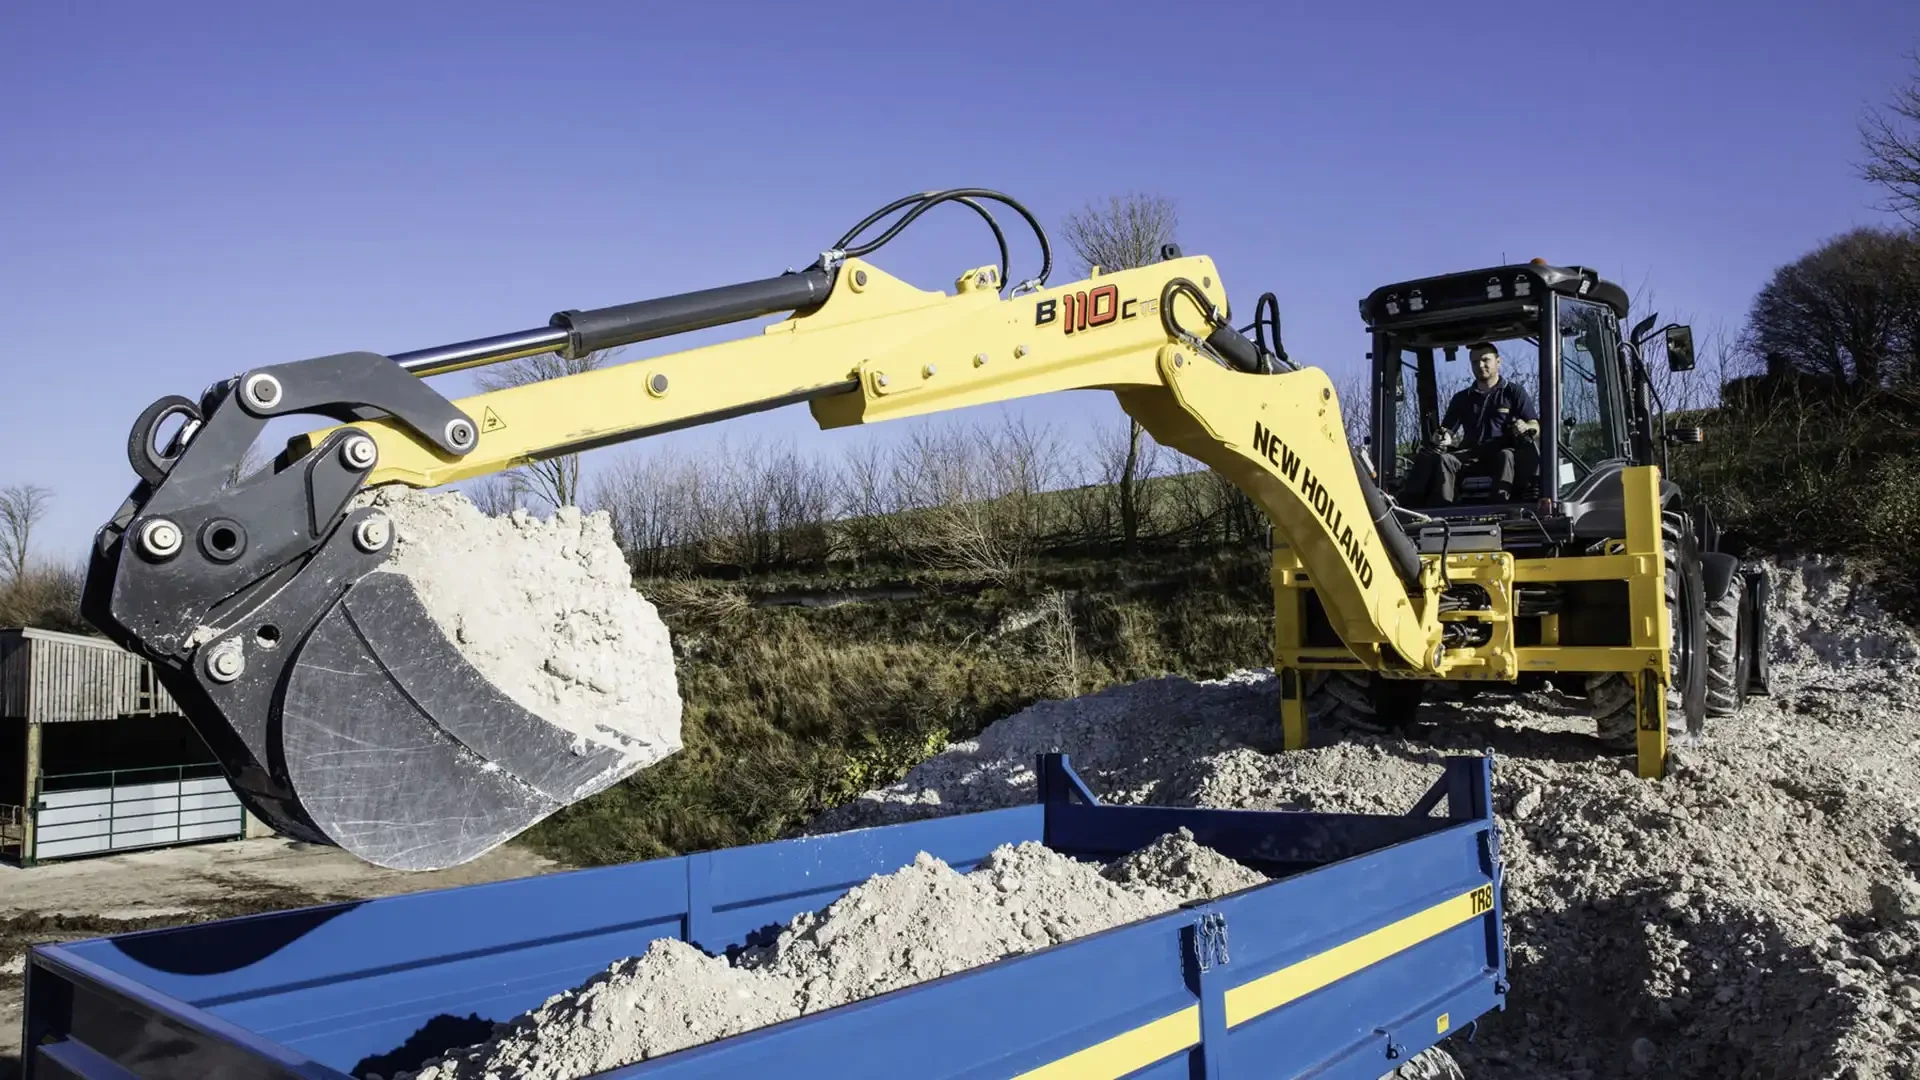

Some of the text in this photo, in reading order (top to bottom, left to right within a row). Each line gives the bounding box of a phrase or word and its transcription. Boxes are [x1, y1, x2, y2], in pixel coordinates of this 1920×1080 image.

[1253, 420, 1373, 590] NEW HOLLAND
[1470, 885, 1492, 915] TR8
